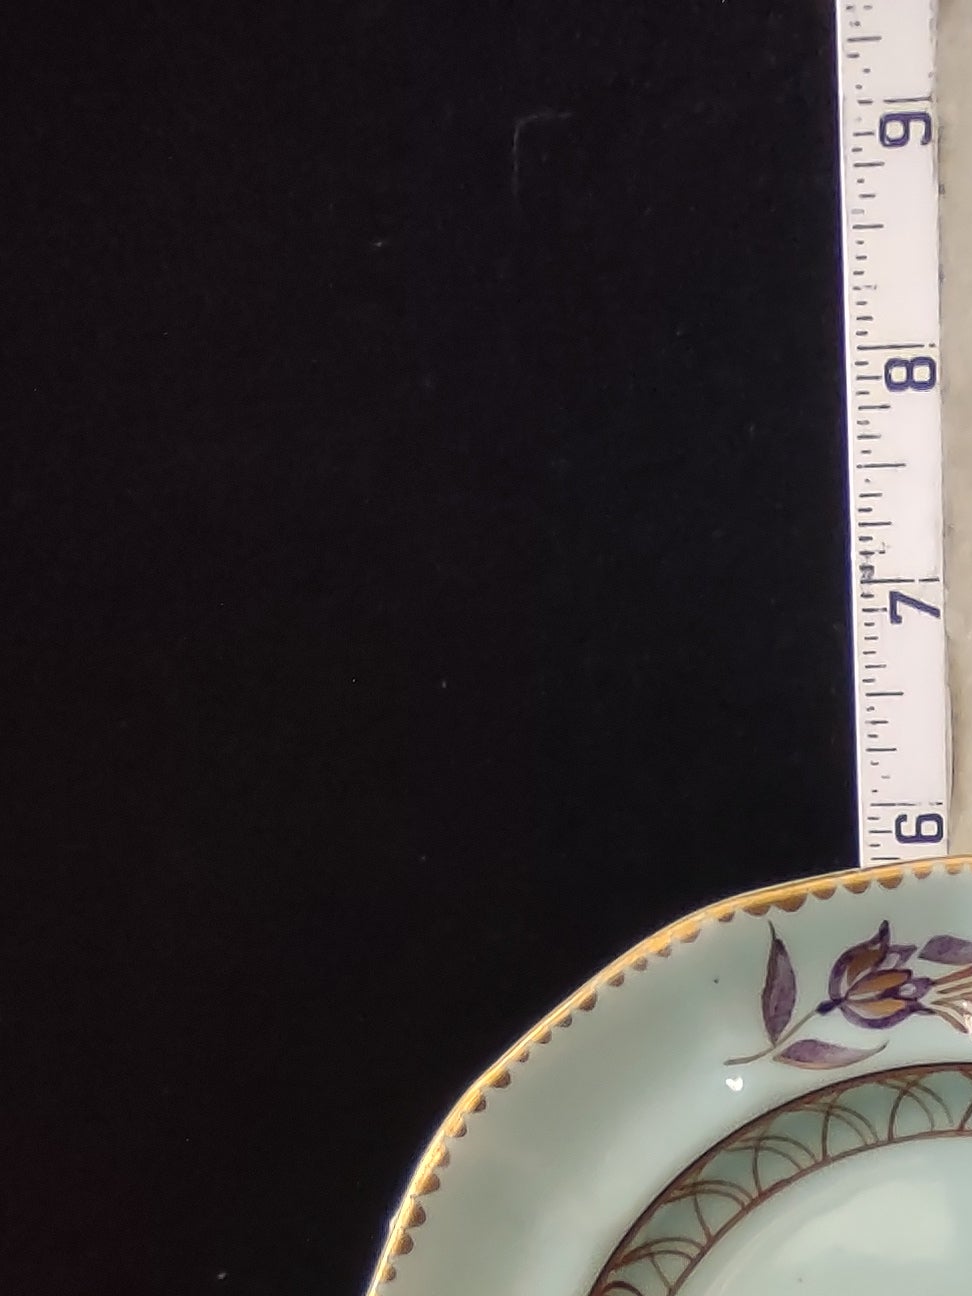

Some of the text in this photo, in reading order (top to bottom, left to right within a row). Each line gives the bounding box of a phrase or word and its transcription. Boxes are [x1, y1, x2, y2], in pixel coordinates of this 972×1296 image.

[879, 111, 932, 148] 9
[884, 356, 936, 392] 8
[889, 591, 941, 624] 7
[895, 813, 944, 844] 6
